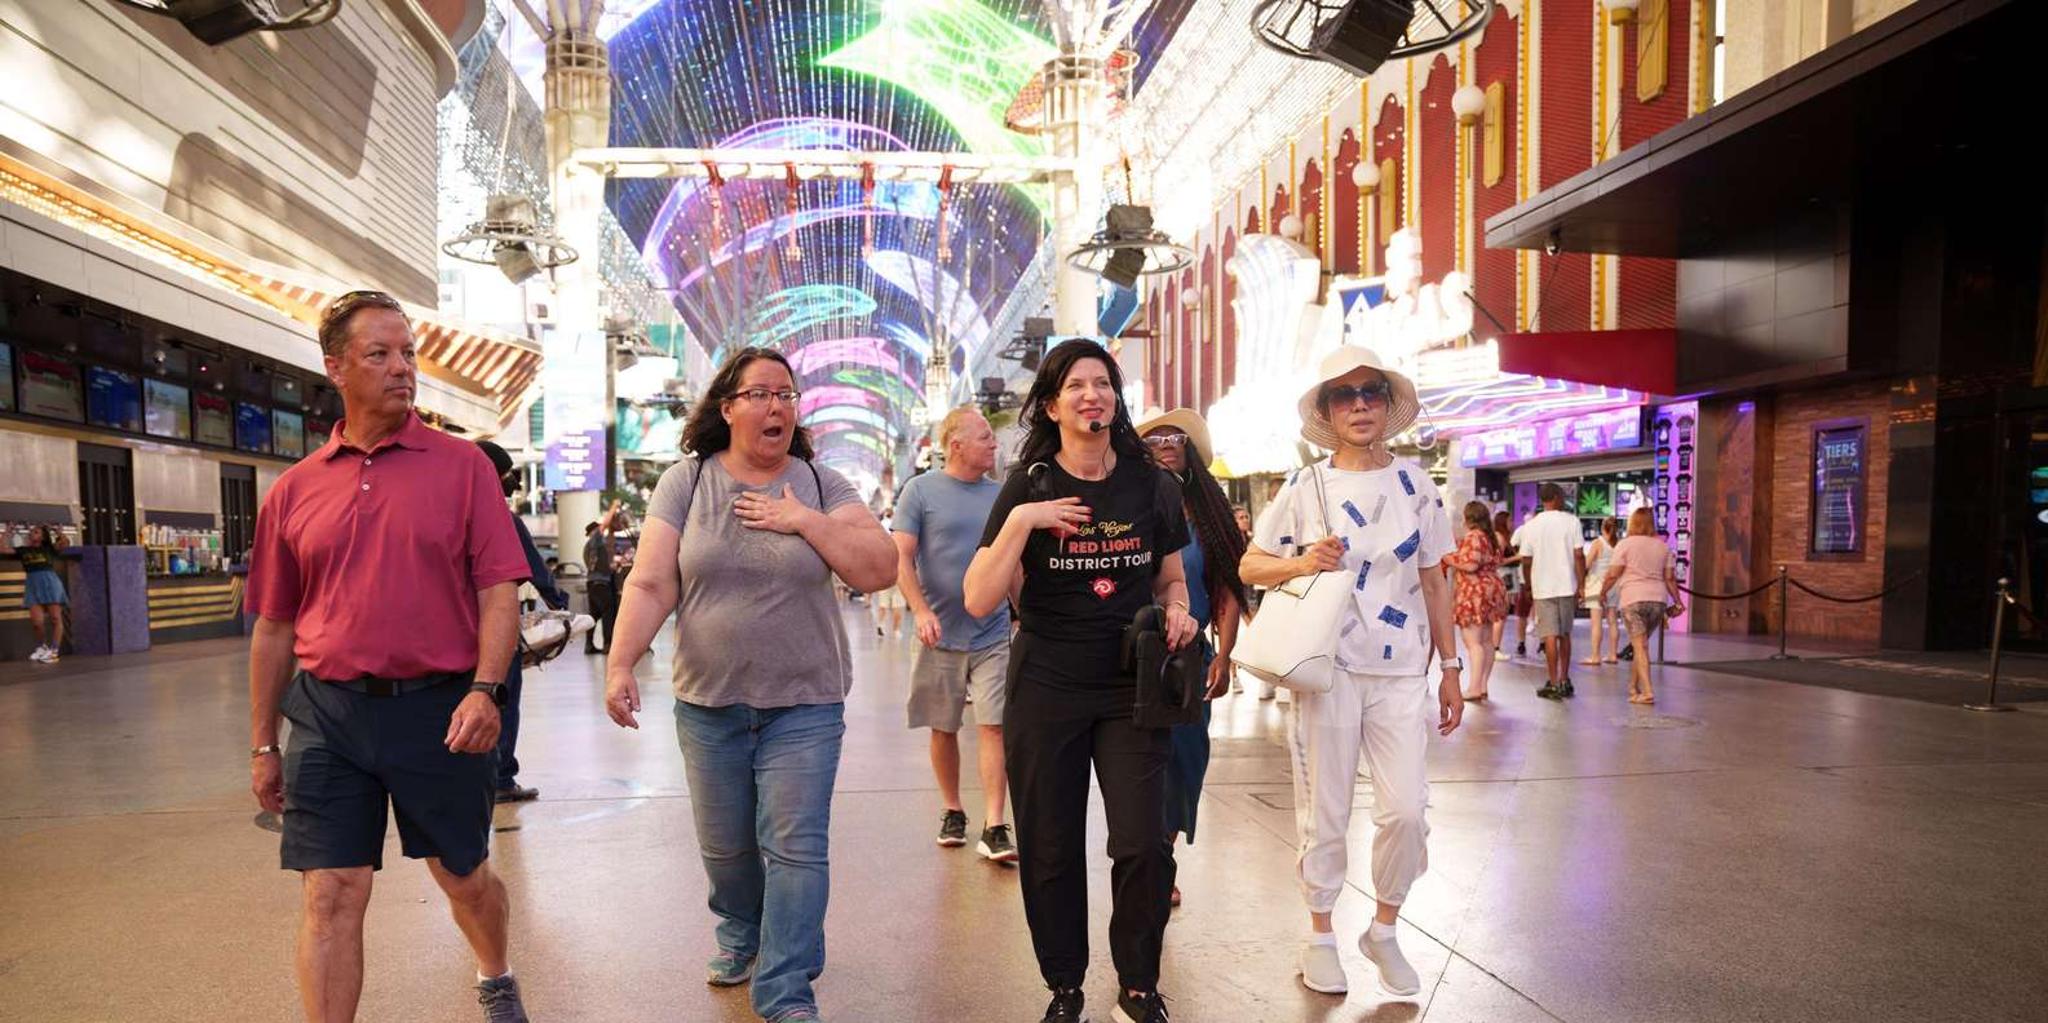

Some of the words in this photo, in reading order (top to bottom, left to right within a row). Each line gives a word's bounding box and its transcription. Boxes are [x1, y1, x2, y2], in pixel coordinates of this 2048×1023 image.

[1824, 442, 1857, 458] TIERS
[1098, 521, 1134, 537] Vegas
[1069, 541, 1098, 553] RED
[1102, 537, 1140, 553] LIGHT
[1049, 556, 1120, 570] DISTRICT
[1123, 551, 1152, 567] TOUR
